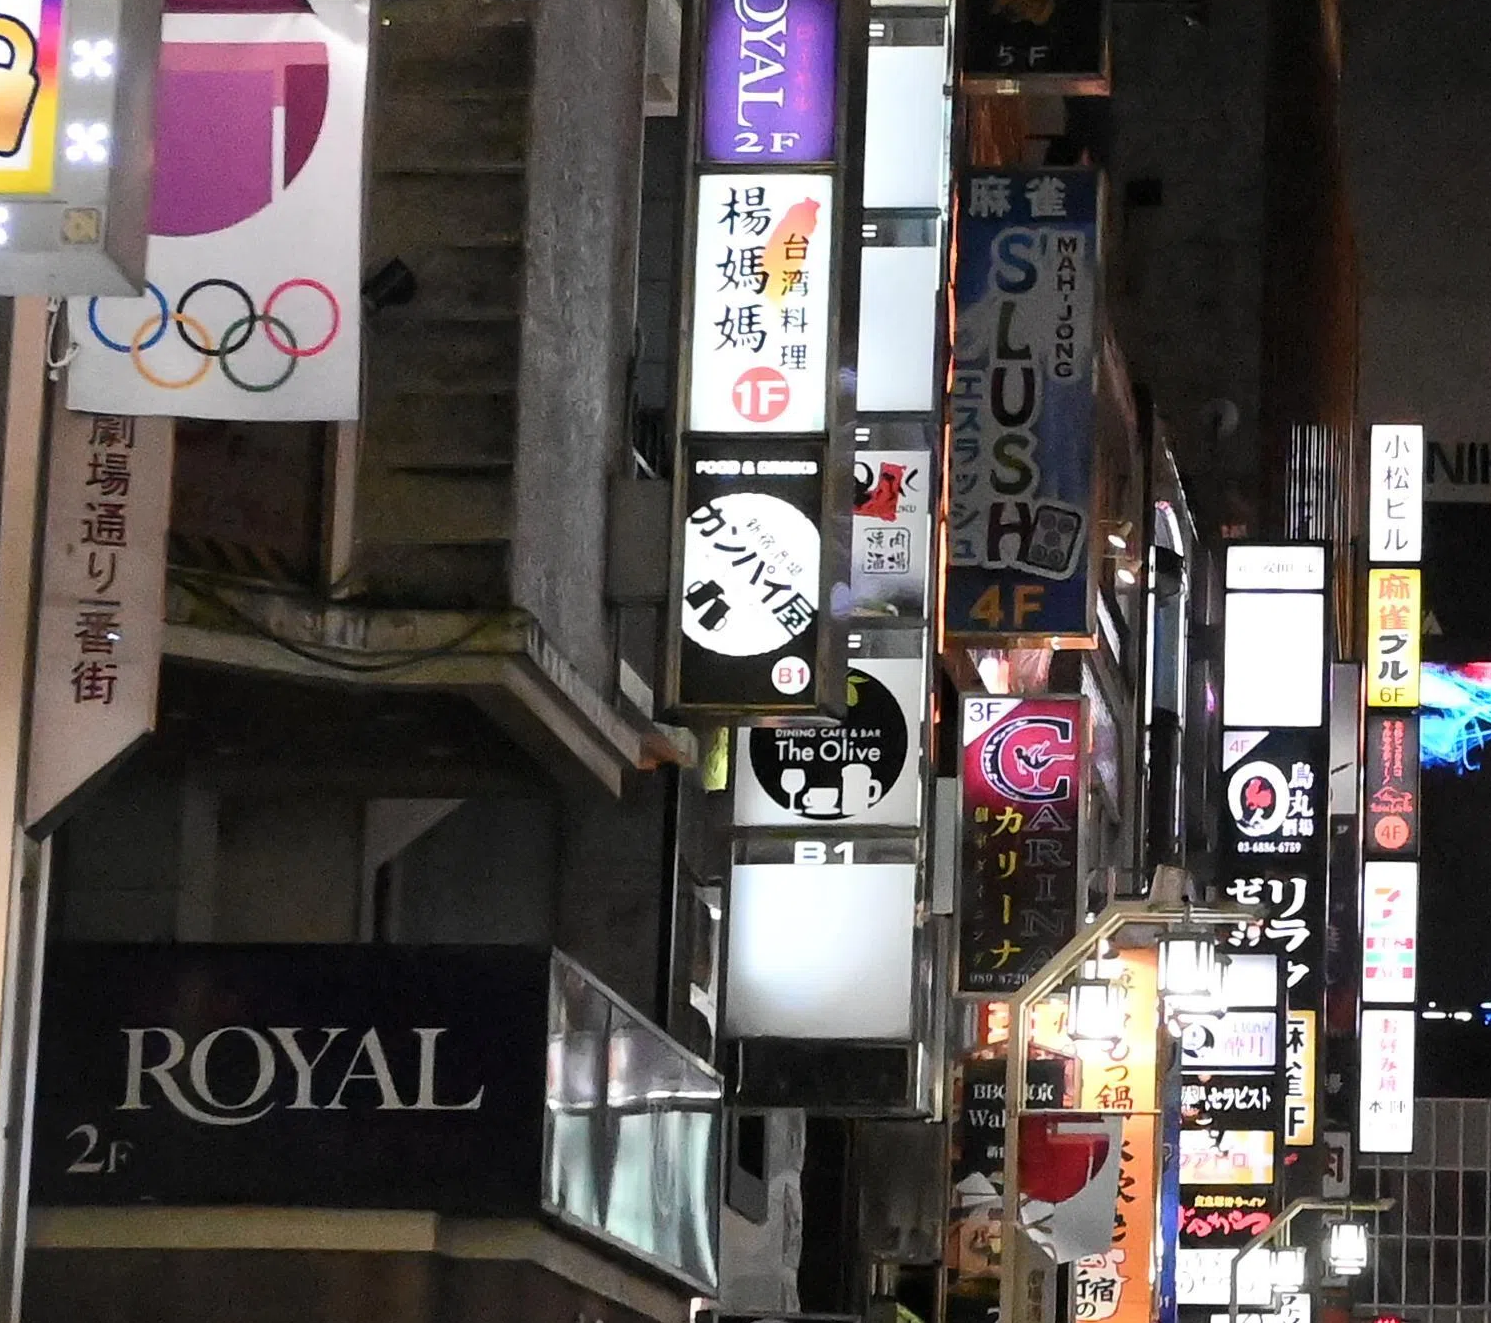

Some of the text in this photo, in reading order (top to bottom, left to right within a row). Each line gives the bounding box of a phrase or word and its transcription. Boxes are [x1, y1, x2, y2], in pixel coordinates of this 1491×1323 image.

[733, 131, 800, 153] 2F
[968, 177, 1067, 217] 麻雀
[714, 186, 772, 353] 楊媽媽
[780, 233, 809, 370] 台湾料理
[733, 380, 786, 415] 1F
[988, 232, 1038, 563] SLUSH
[1383, 433, 1410, 552] 小松ビル
[691, 505, 819, 636] カンパイ屋
[970, 584, 1044, 628] 4F
[778, 667, 806, 685] B1
[1379, 686, 1406, 703] 6F
[969, 702, 1002, 722] 3F
[775, 728, 816, 738] DINING
[820, 728, 847, 738] CAFE
[863, 728, 881, 738] BAR
[775, 739, 881, 762] The Olive
[1229, 740, 1249, 753] 4F
[1380, 825, 1402, 840] 4F
[794, 840, 855, 865] B1
[991, 806, 1023, 970] カリーナ
[117, 1025, 485, 1127] ROYAL
[65, 1125, 134, 1175] 2F
